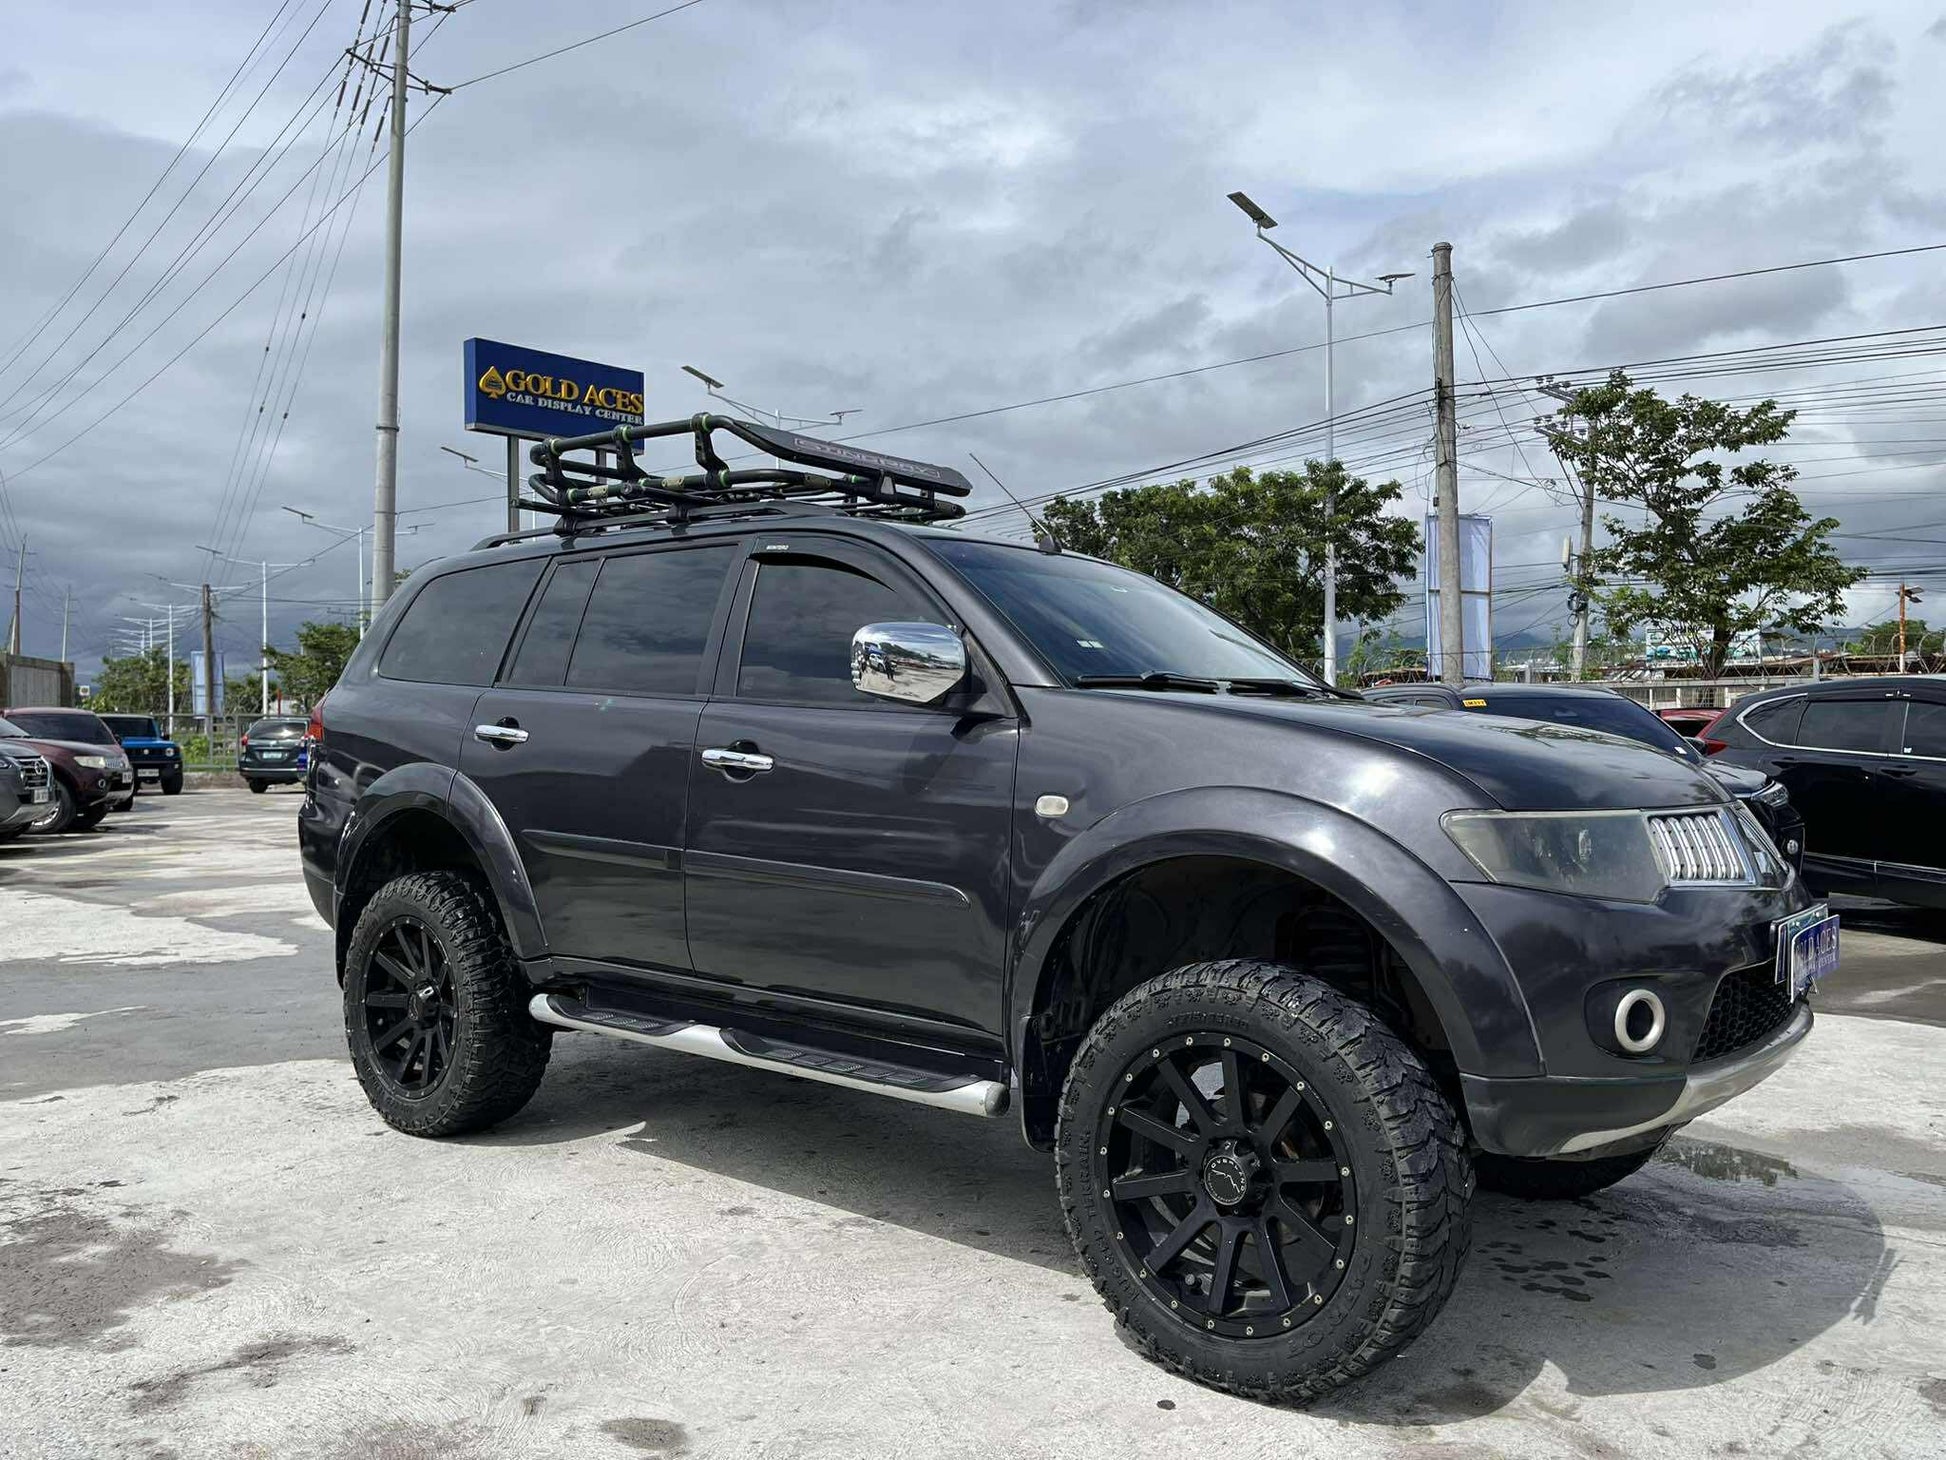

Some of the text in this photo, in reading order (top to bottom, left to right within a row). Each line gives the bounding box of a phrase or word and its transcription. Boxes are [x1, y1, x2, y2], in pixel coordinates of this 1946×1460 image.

[505, 370, 644, 414] GOLD ACES
[506, 392, 644, 425] CAR DISPLAY CENTER
